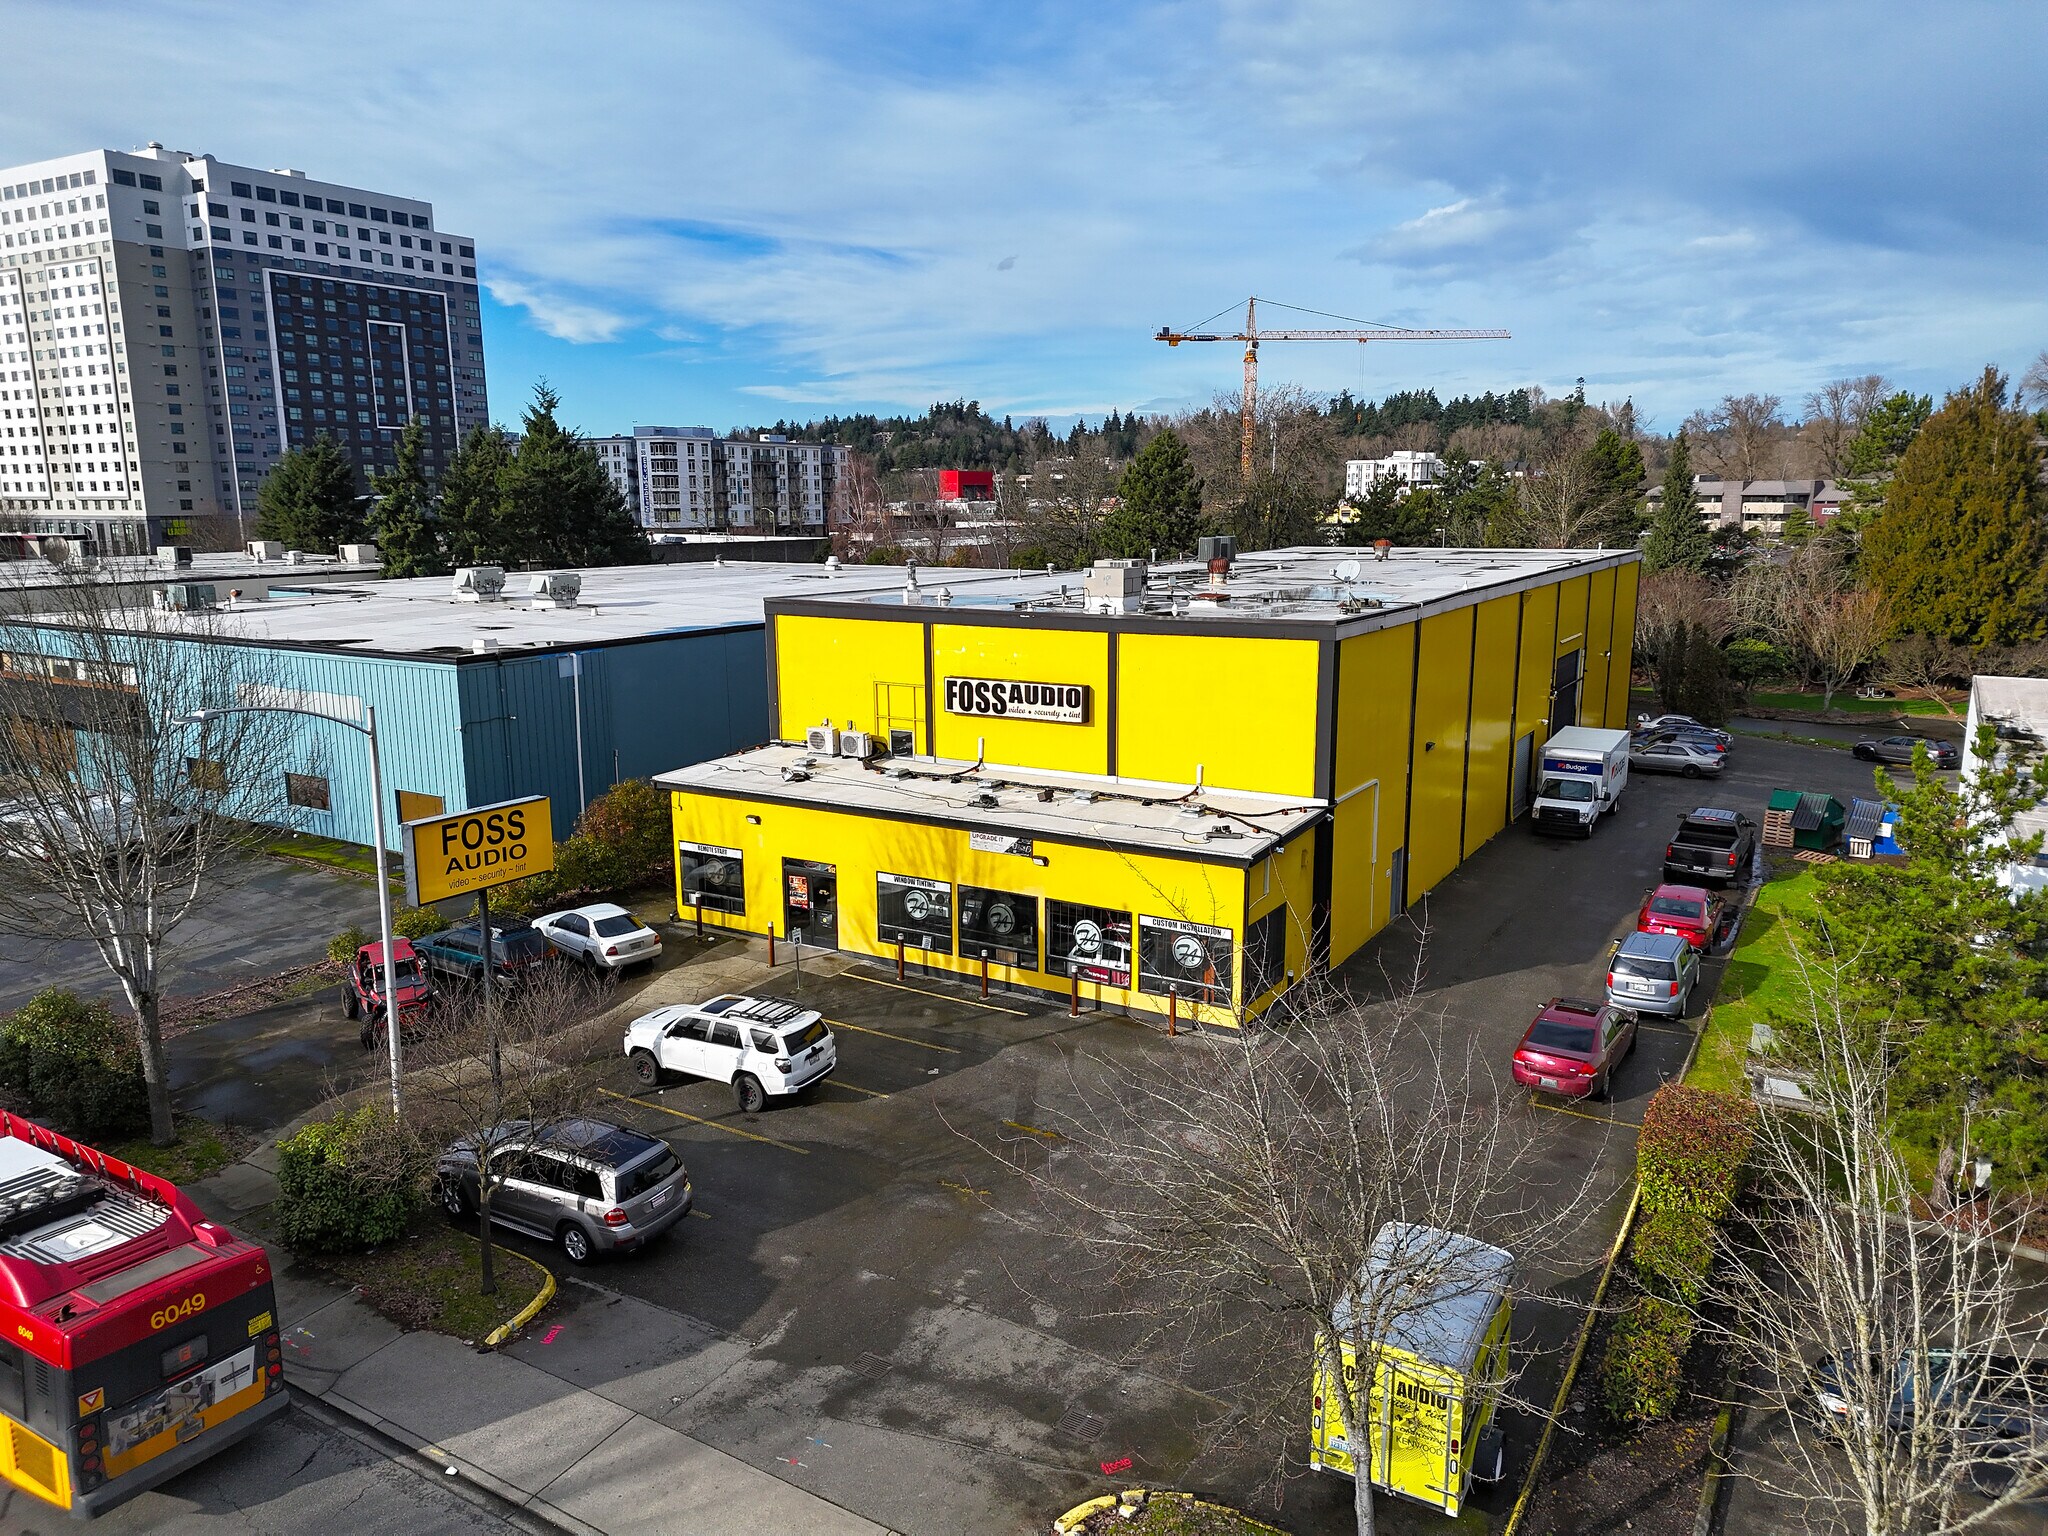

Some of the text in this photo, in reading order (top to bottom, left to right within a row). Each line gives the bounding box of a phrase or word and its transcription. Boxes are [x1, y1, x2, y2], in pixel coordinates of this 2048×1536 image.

[946, 680, 1081, 715] FOSS AUDIO
[1008, 706, 1081, 719] video security tint
[1565, 763, 1588, 772] Budget
[441, 809, 526, 856] FOSS
[971, 833, 997, 842] UPGRADE
[444, 843, 528, 875] AUDIO
[448, 862, 527, 890] video security tint
[893, 875, 936, 889] WINDOW TINTING
[1152, 918, 1222, 936] CUSTOM INSTALLATION
[150, 1293, 206, 1330] 6049
[17, 1325, 34, 1341] 6049
[1396, 1381, 1448, 1410] AUDIO
[1395, 1435, 1443, 1456] KENWOOD
